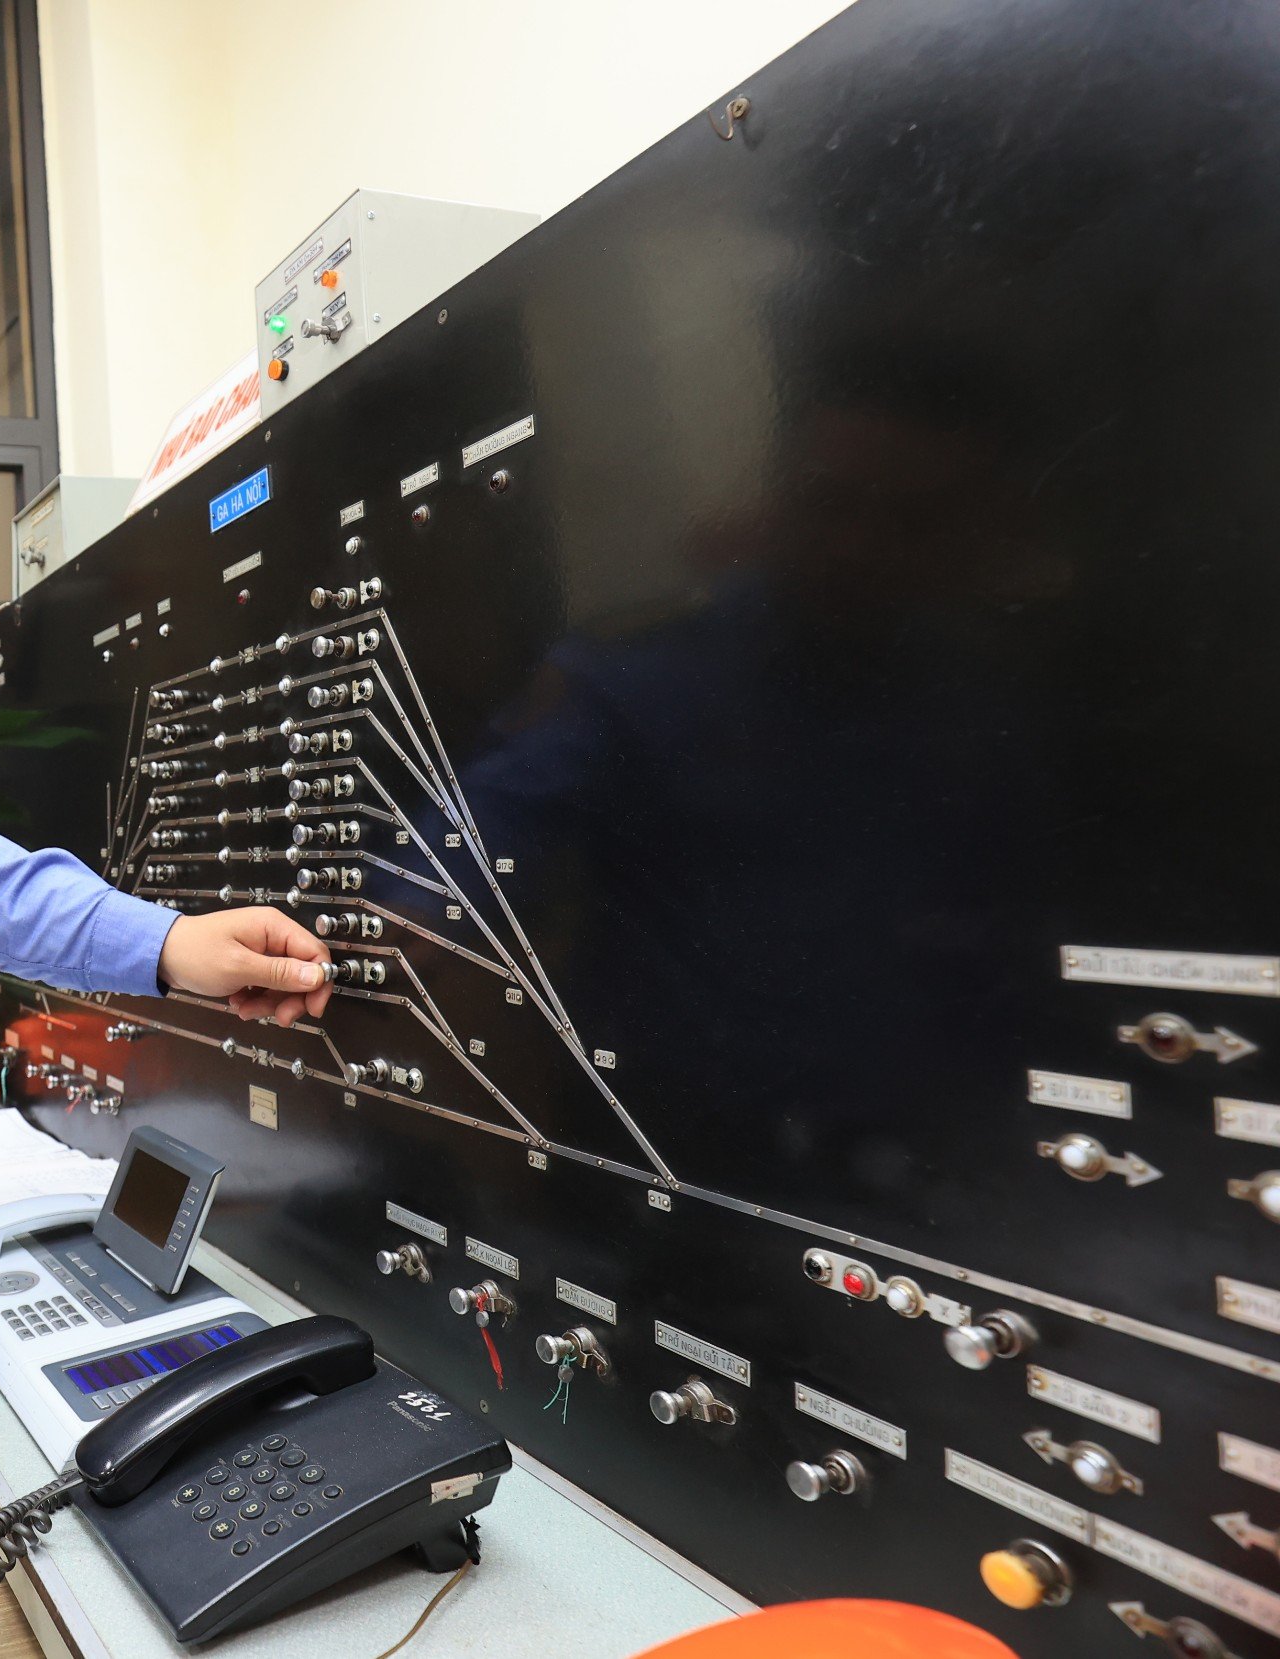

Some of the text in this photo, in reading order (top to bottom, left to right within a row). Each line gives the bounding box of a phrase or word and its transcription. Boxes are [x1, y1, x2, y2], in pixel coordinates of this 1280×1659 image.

[506, 425, 528, 442] NGANG
[216, 478, 262, 522] GA HÀ NỘI
[662, 1333, 679, 1348] TRỞ
[680, 1340, 702, 1358] NGẠI
[702, 1349, 720, 1365] GỬI
[398, 1391, 452, 1421] 2561
[386, 1400, 432, 1432] Panasonic
[842, 1413, 891, 1443] CHUÔNG
[269, 1438, 280, 1446] 1
[241, 1454, 251, 1462] 4
[211, 1470, 223, 1479] 7
[257, 1469, 269, 1478] 5
[305, 1469, 318, 1478] 3
[228, 1486, 240, 1496] 8
[276, 1485, 288, 1495] 6
[199, 1505, 211, 1514] 0
[245, 1503, 258, 1513] 9
[215, 1522, 229, 1533] #
